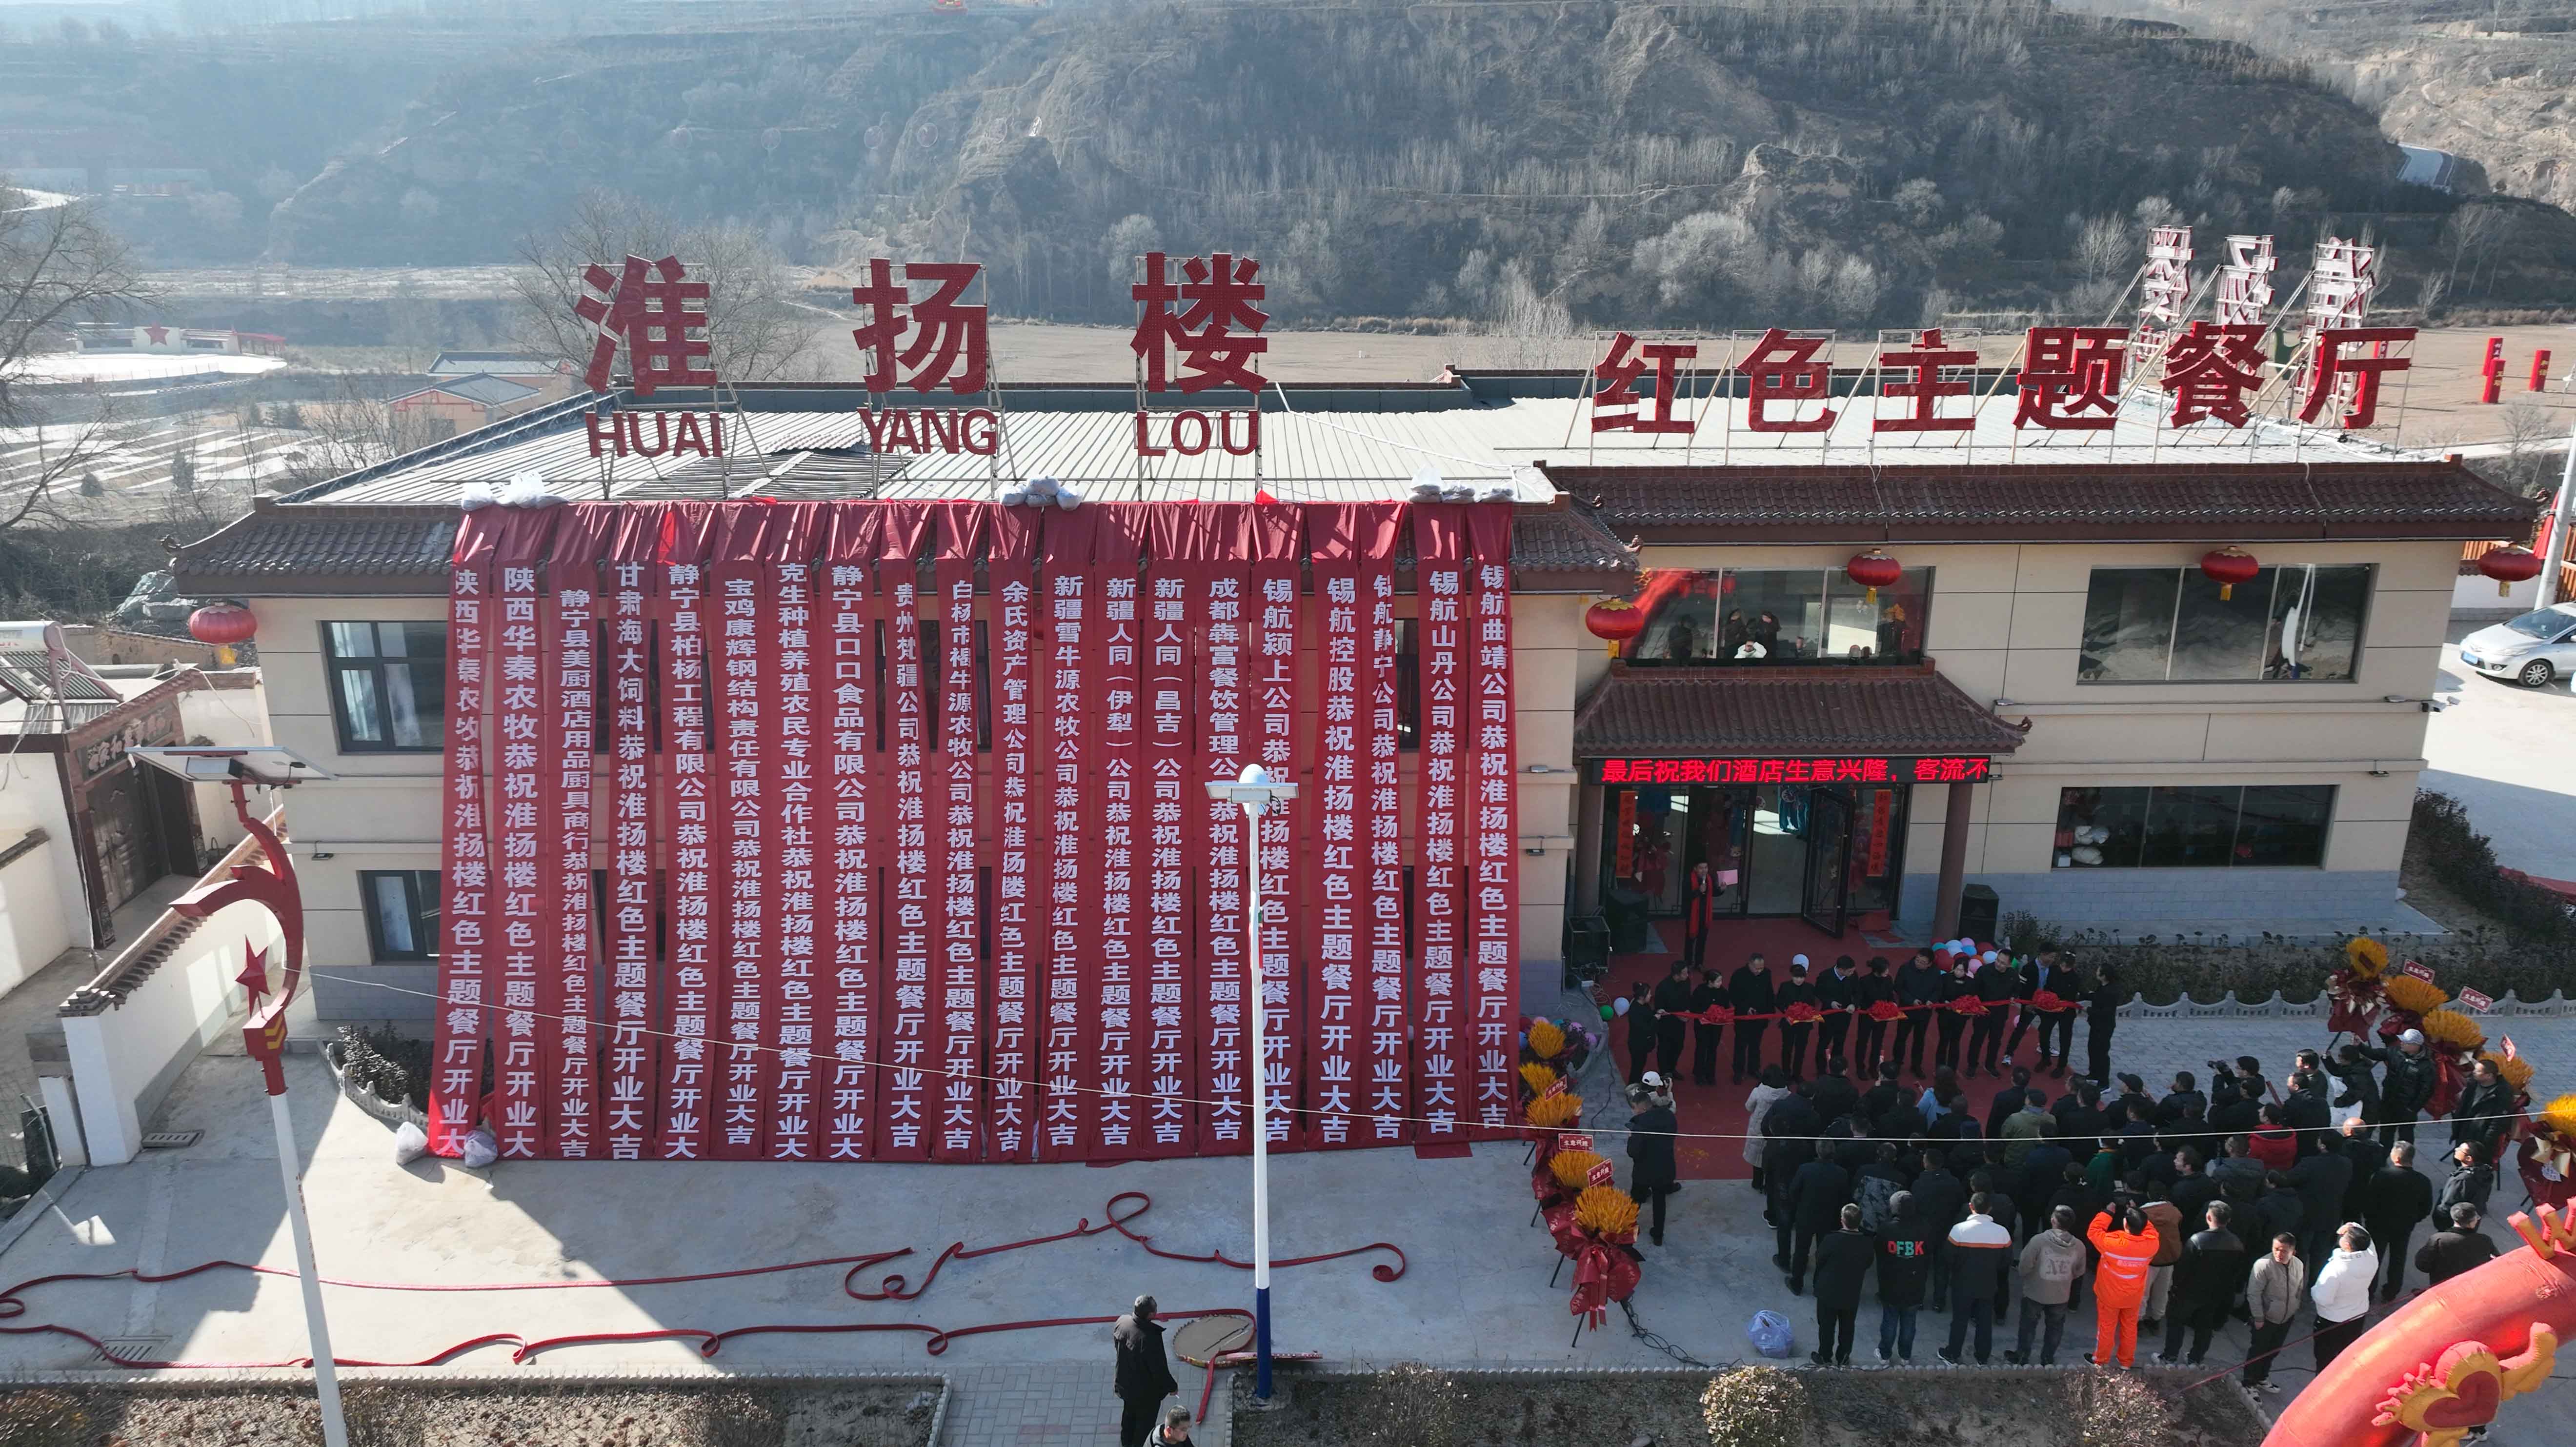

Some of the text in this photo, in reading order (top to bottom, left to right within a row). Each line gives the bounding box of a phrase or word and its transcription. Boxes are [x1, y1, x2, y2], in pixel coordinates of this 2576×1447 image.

[574, 251, 1270, 396] 淮扬楼
[585, 406, 1260, 458] HUAI YANG LOU
[1591, 320, 2418, 433] 红色主题餐厅
[503, 567, 539, 1157] 陕西华秦农牧恭祝淮扬楼红色主题餐厅开业大
[560, 589, 592, 1157] 静宁县美厨酒店用品厨具商行恭祝淮扬楼红色主题餐厅开业大吉
[609, 562, 647, 1160] 甘肃海大饲料恭祝淮扬楼红色主题餐厅开业大吉
[664, 564, 709, 1158] 静宁县柏杨工程有限公司恭祝淮扬楼红色主题餐厅开业大
[724, 579, 762, 1144] 宝鸡康辉钢结构责任有限公司恭祝淮扬楼红色主题餐厅开业大吉
[774, 563, 814, 1158] 克生种植养殖农民专业合作社恭祝淮扬楼红色主题餐厅开业大
[829, 565, 868, 1159] 静宁县口口食品有限公司恭祝淮扬楼红色主题餐厅开业大
[1047, 576, 1084, 1146] 新疆雪牛源农牧公司恭祝淮扬楼红色主题餐厅开业大吉
[1208, 577, 1242, 1141] 成都犇富餐饮管理公恭祝淮扬楼红色主题餐厅开业大吉
[1320, 577, 1356, 1143] 锡航控股恭祝淮扬楼红色主题餐厅开业大吉
[1423, 570, 1459, 1134] 锡航山丹公司恭祝淮扬楼红色主题餐厅开业大吉
[1477, 564, 1509, 1128] 锡航曲靖公司恭祝淮扬楼红色主题餐厅开业大吉
[1888, 1241, 1925, 1256] DFBK
